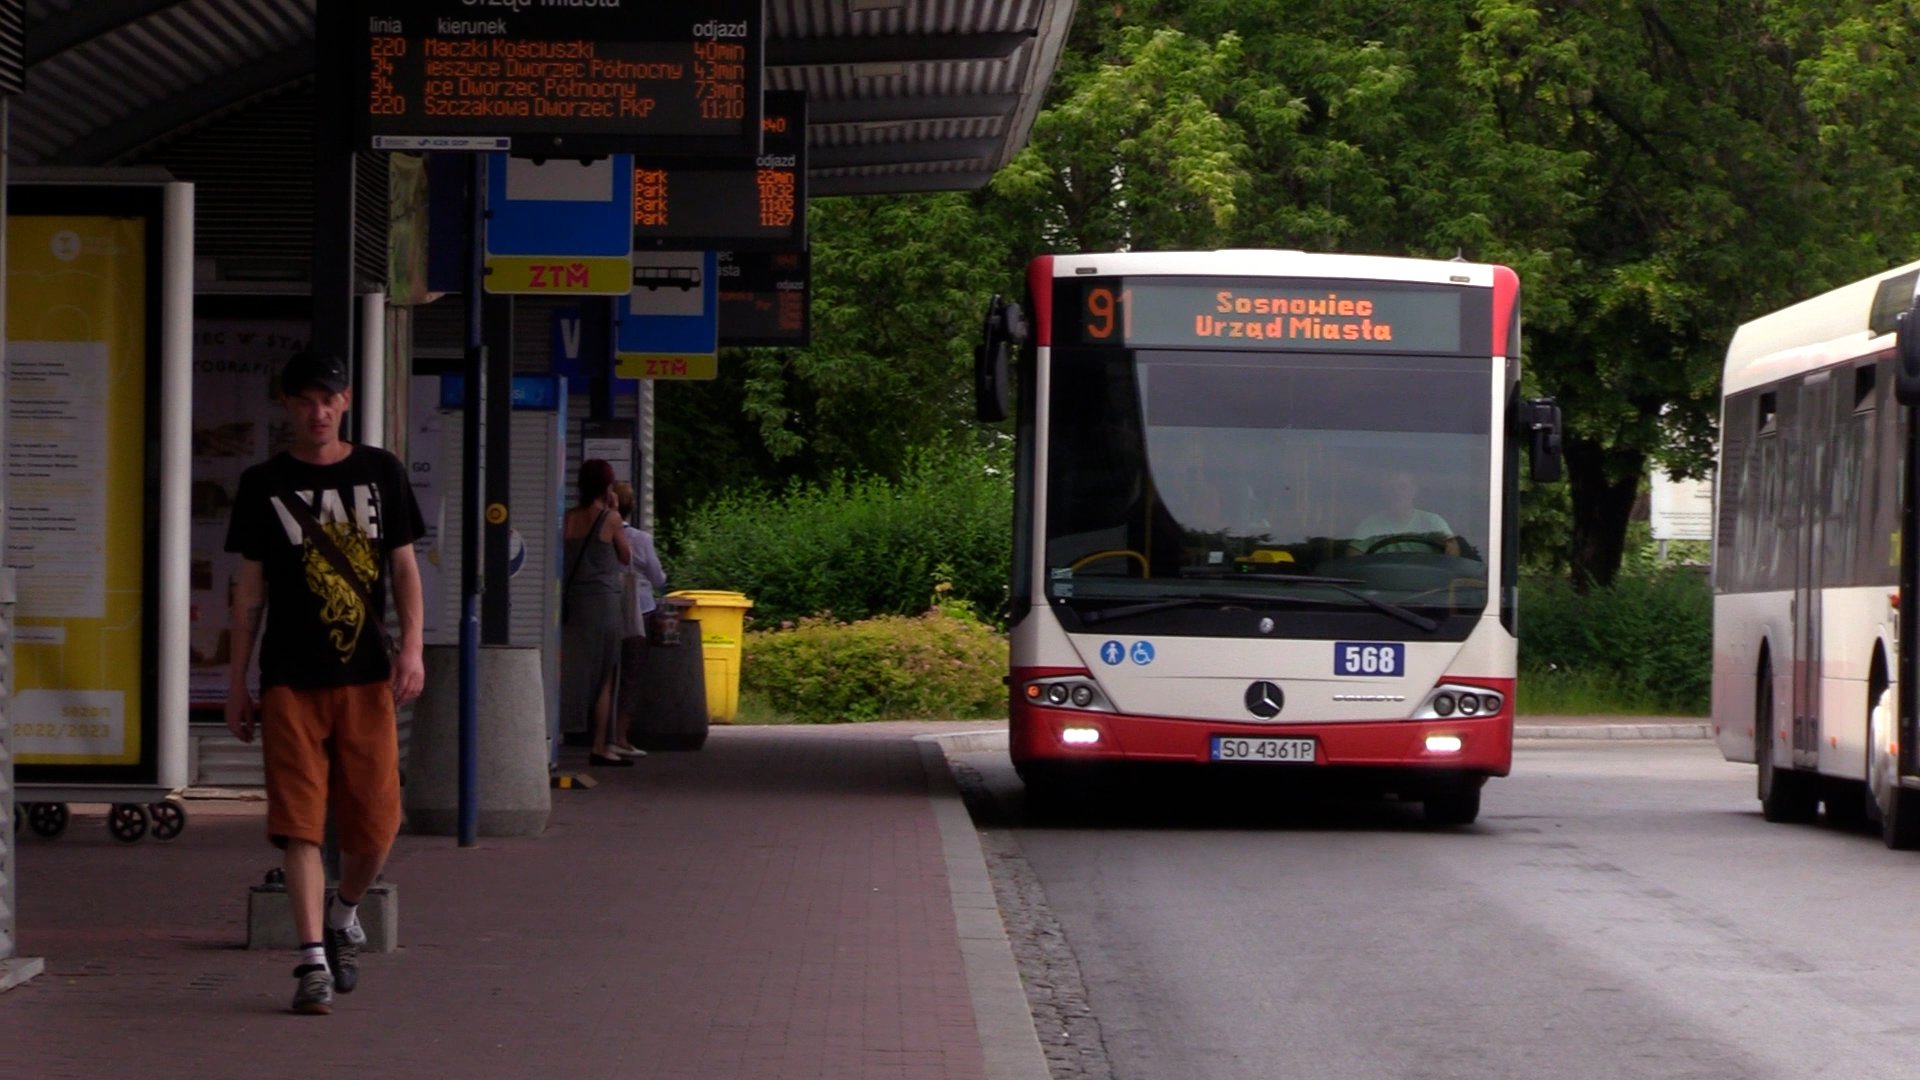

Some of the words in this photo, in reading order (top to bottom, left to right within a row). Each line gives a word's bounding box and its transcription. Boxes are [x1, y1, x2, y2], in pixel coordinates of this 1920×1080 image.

[370, 17, 402, 33] linia
[438, 18, 507, 34] kierunek
[693, 20, 747, 41] odjazd
[370, 38, 406, 56] 220
[425, 38, 488, 57] Maczki
[494, 39, 594, 58] Kościuszki
[694, 41, 744, 60] 40min
[371, 57, 393, 76] 34
[507, 59, 585, 77] Dworzec
[592, 60, 683, 79] Północny
[694, 61, 744, 80] 43min
[371, 76, 393, 95] 34
[460, 77, 539, 96] Dworzec
[545, 79, 636, 97] Północny
[696, 81, 744, 99] 73min
[370, 95, 405, 114] 220
[425, 96, 528, 115] Szczakowa
[534, 98, 614, 117] Dworzec
[620, 99, 655, 117] PKP
[700, 100, 743, 118] 11:10
[756, 154, 796, 169] odjazd
[635, 169, 667, 183] Park
[635, 183, 667, 197] Park
[635, 197, 667, 211] Park
[635, 211, 667, 225] Park
[529, 264, 589, 288] ZTM
[1087, 288, 1133, 339] 91
[1216, 291, 1373, 316] Sosnowiec
[1195, 315, 1282, 340] Urząd
[1288, 317, 1392, 341] Miasta
[645, 359, 688, 376] ZTM
[1345, 647, 1395, 673] 568
[1223, 740, 1249, 758] SO
[1255, 741, 1312, 759] 4361P
